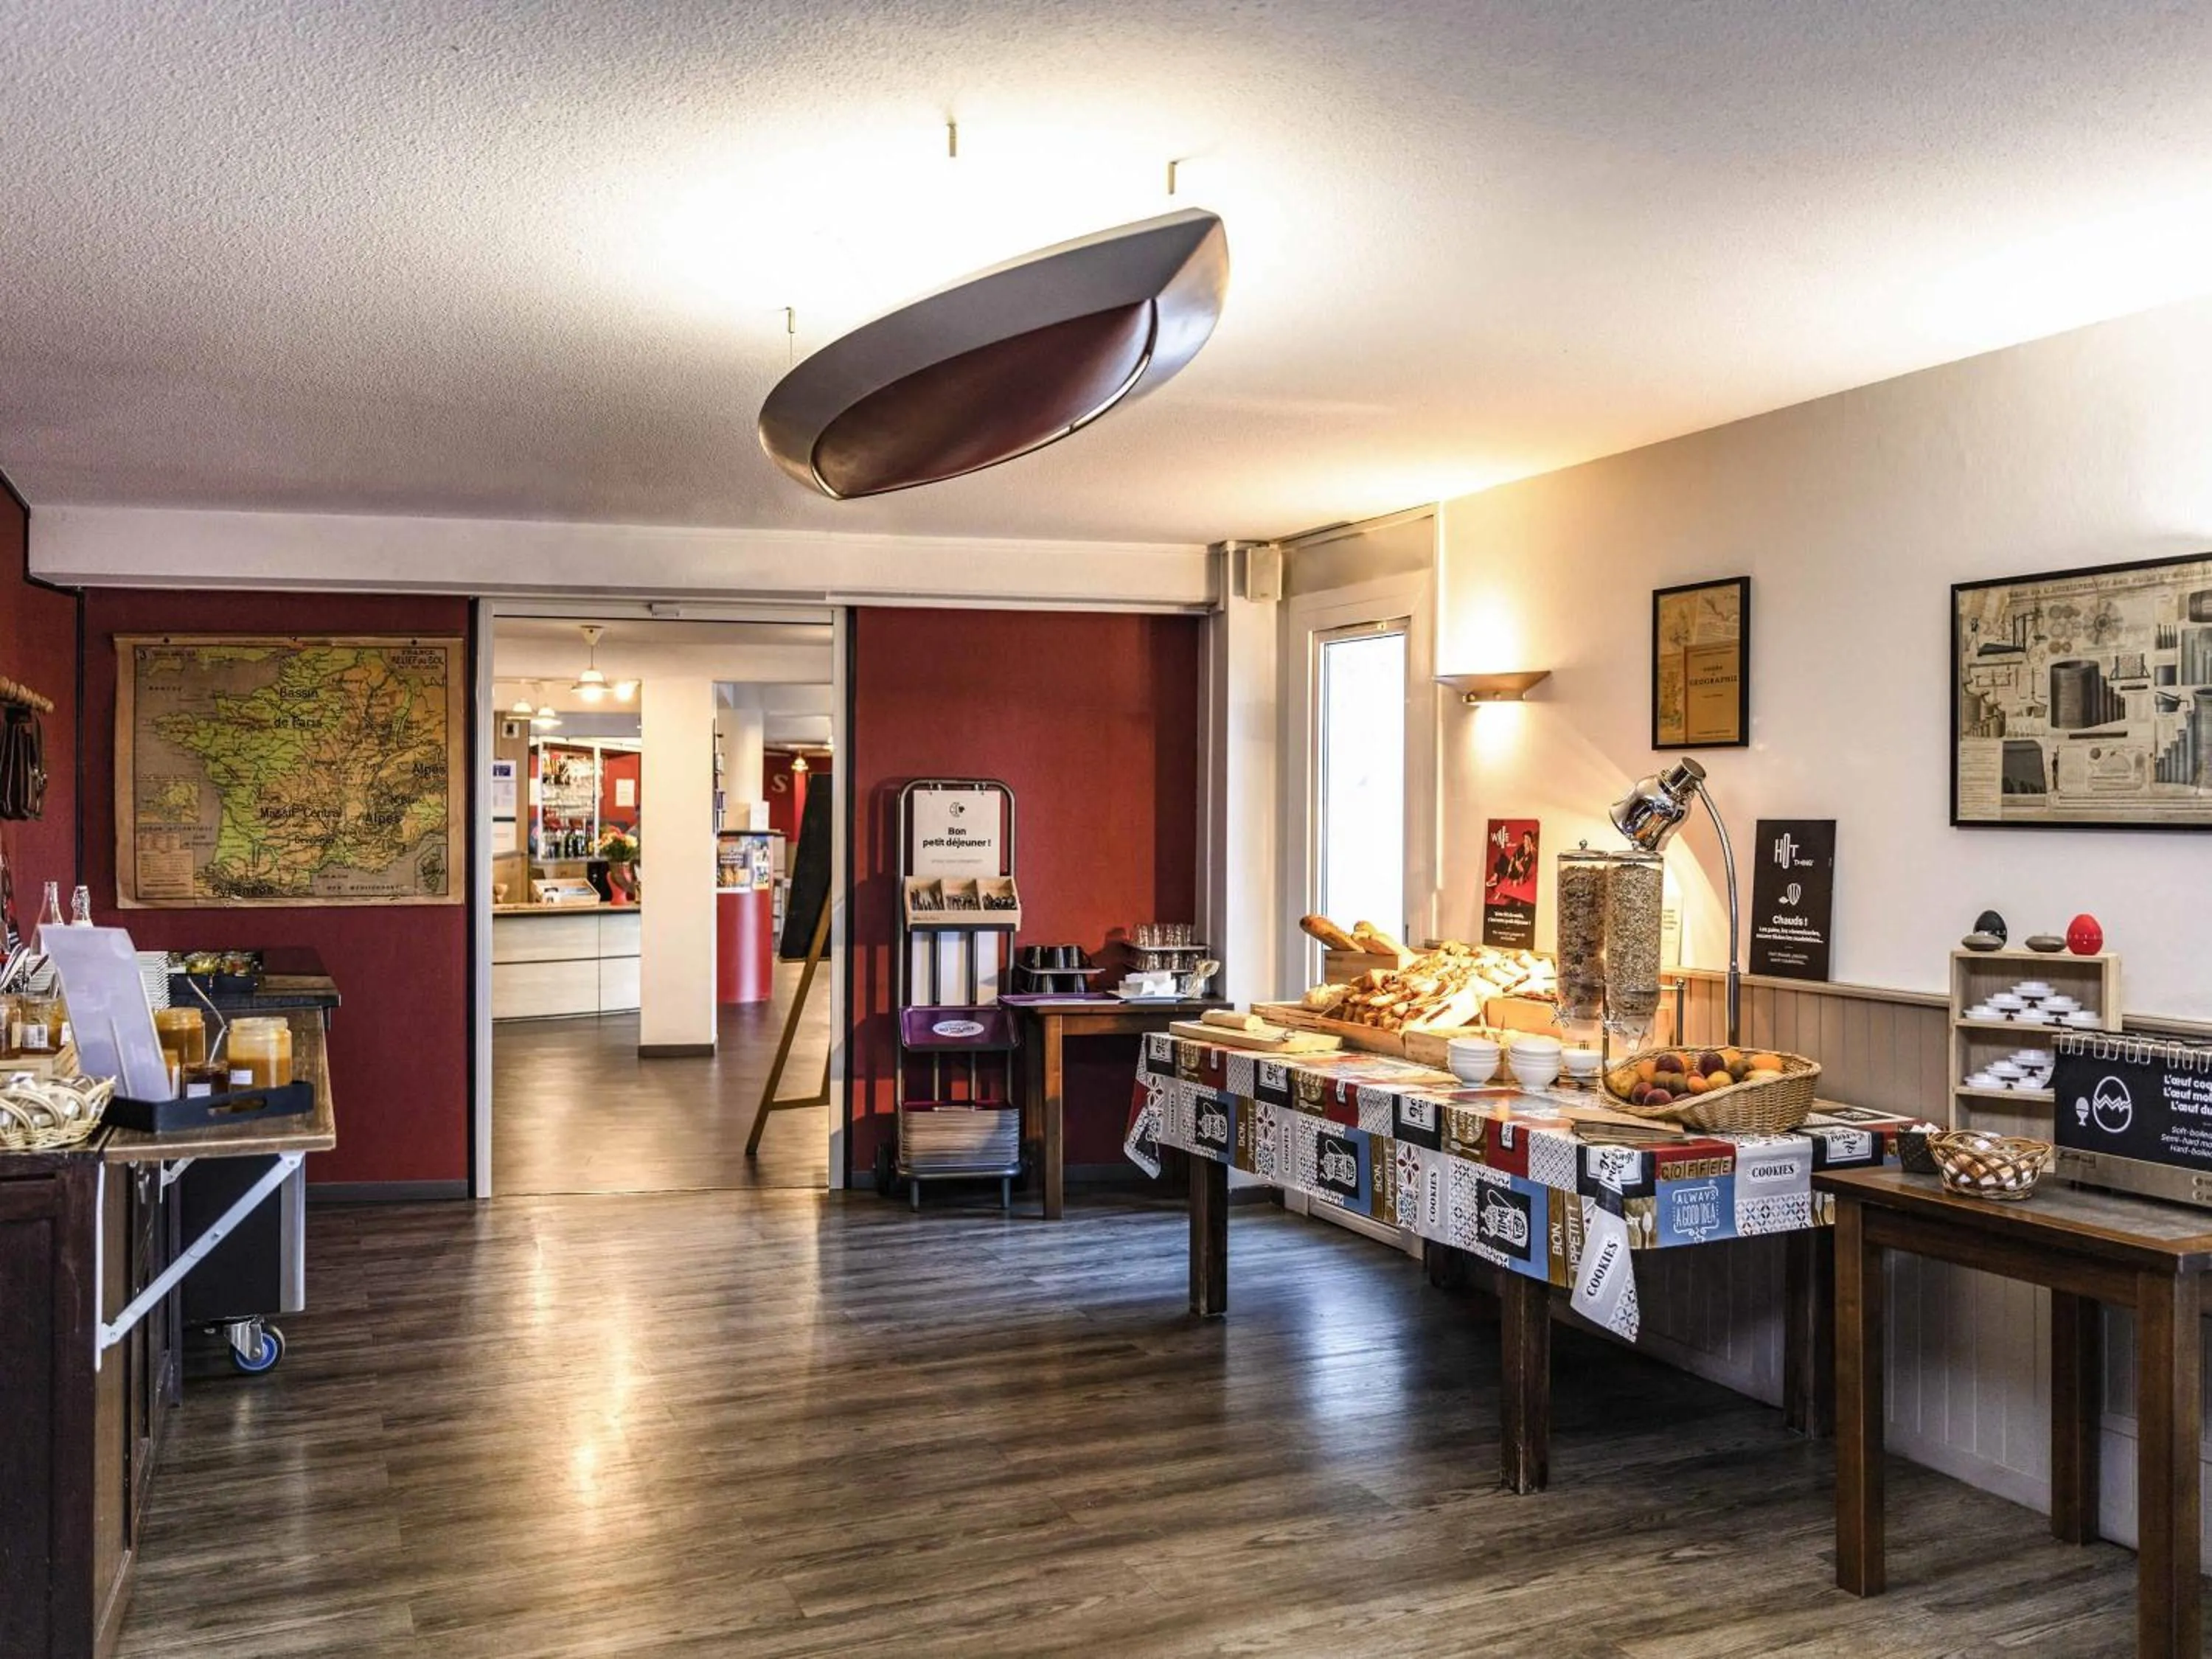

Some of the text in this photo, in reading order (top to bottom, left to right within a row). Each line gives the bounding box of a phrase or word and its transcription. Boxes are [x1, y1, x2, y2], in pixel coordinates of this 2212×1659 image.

[279, 686, 319, 698] Bassin
[274, 715, 323, 728] de Paris
[411, 763, 446, 779] Alpes
[771, 773, 789, 793] S
[260, 806, 342, 818] Massif Central
[363, 813, 401, 825] Alpes
[947, 827, 967, 835] Bon
[922, 838, 945, 849] petit
[946, 838, 987, 849] déjeuner
[1774, 832, 1799, 869] HOT
[1772, 914, 1804, 926] Chauds
[1334, 1155, 1343, 1178] TIME
[1660, 1158, 1731, 1179] COFFEE
[1751, 1164, 1795, 1178] COOKIES
[1374, 1164, 1383, 1192] BON
[1429, 1171, 1438, 1224] COOKIES
[1676, 1189, 1717, 1204] ALWAYS
[1498, 1207, 1509, 1235] TIME
[1676, 1209, 1682, 1227] A
[1682, 1206, 1700, 1225] GOOD
[1551, 1221, 1562, 1256] BON
[1586, 1241, 1619, 1298] COOKIES
